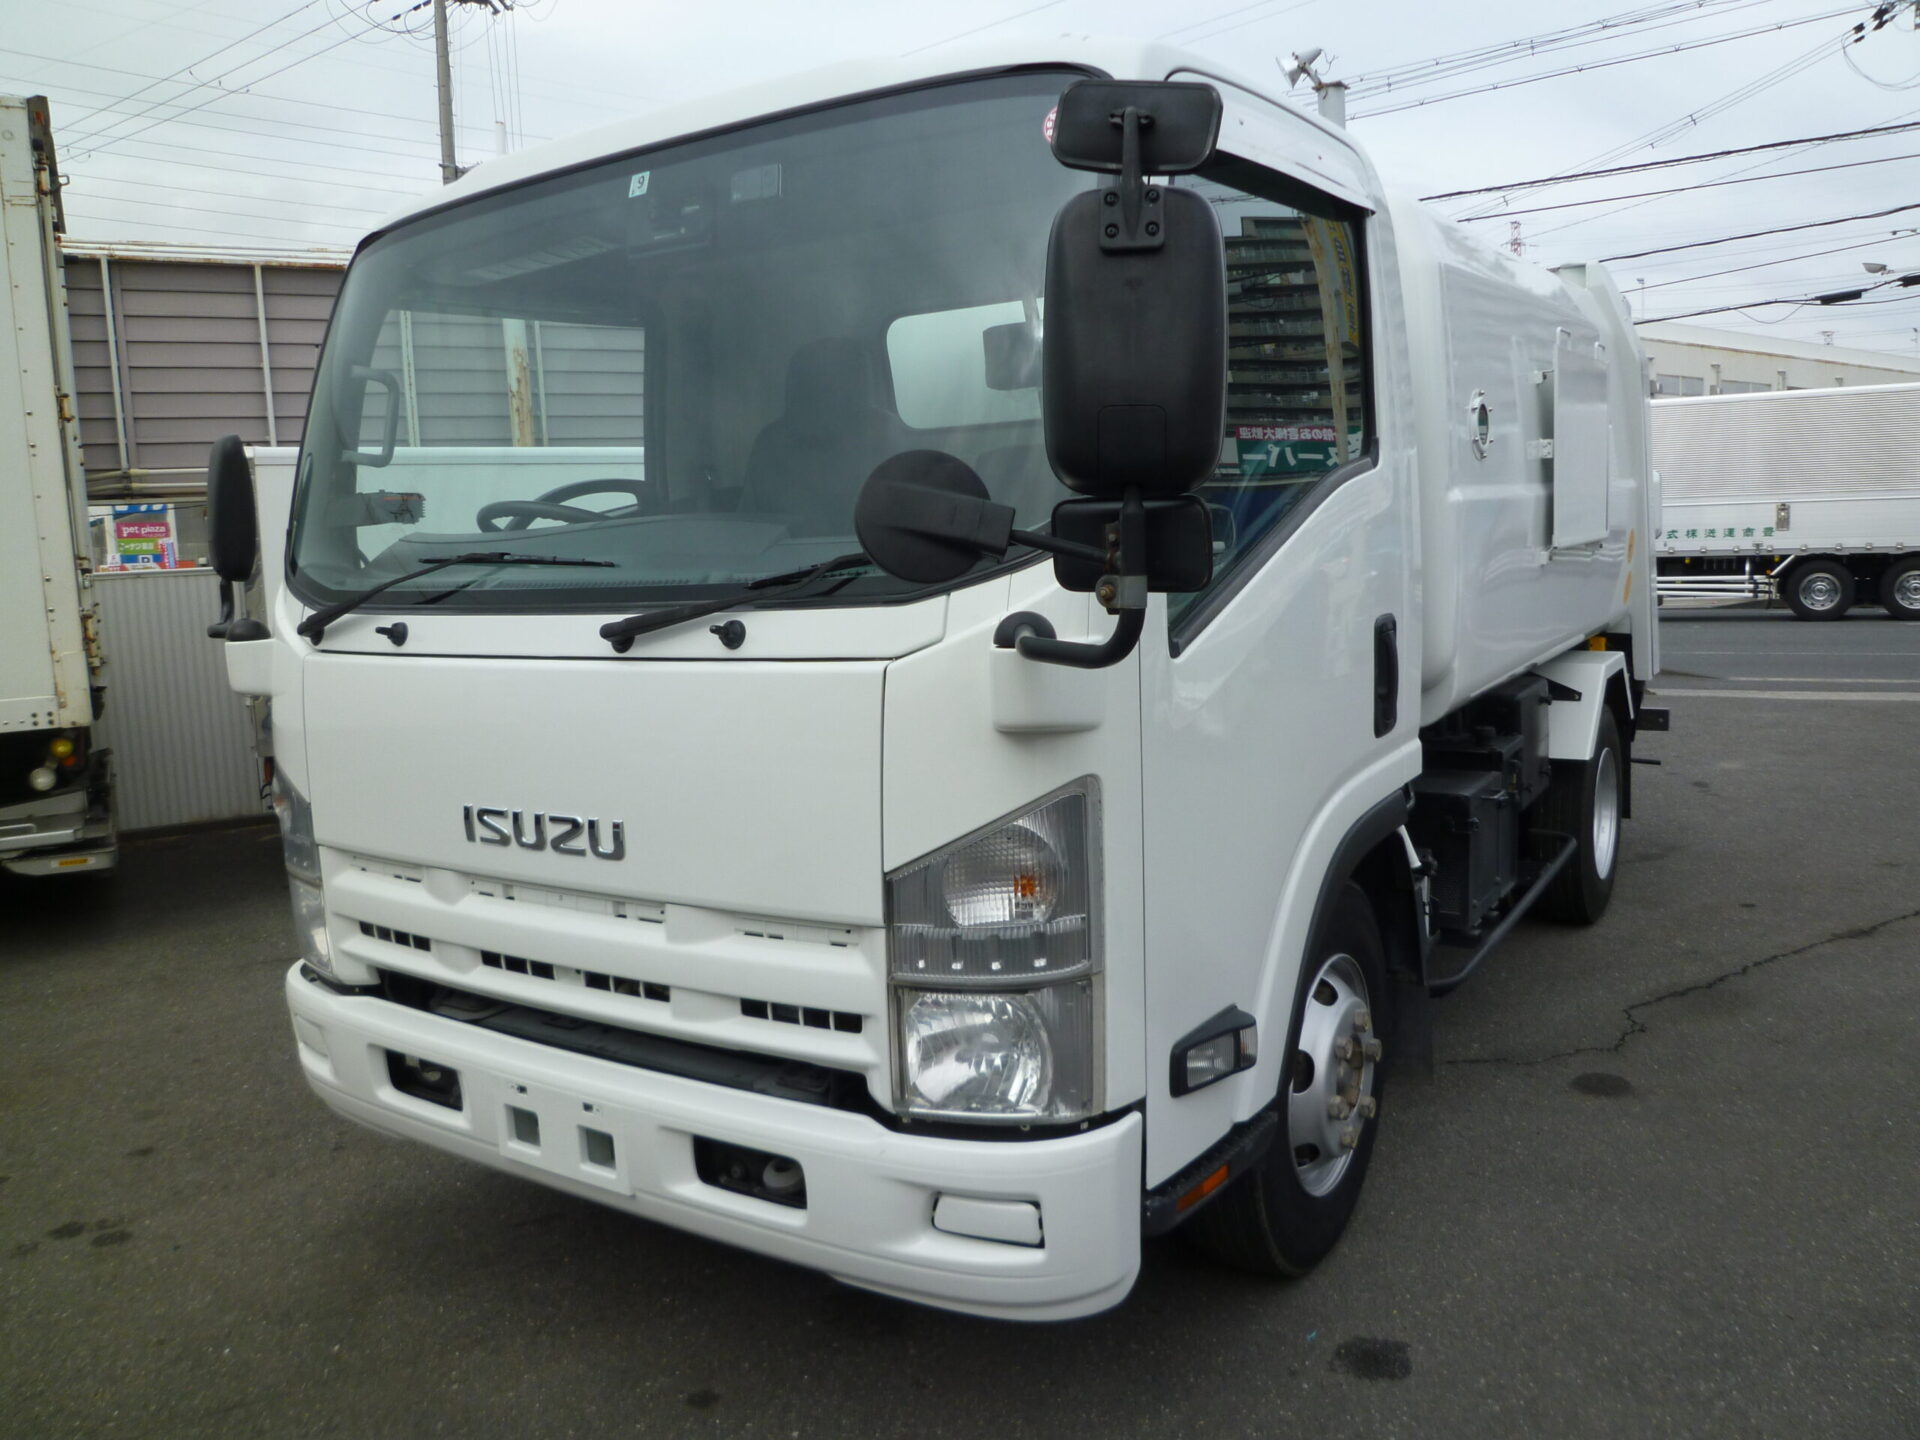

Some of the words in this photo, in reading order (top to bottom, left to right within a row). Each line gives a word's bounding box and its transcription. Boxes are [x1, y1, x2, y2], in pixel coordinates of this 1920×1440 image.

[637, 175, 645, 190] 9
[123, 526, 140, 537] pet
[142, 526, 166, 534] plaza
[463, 803, 626, 861] ISUZU
